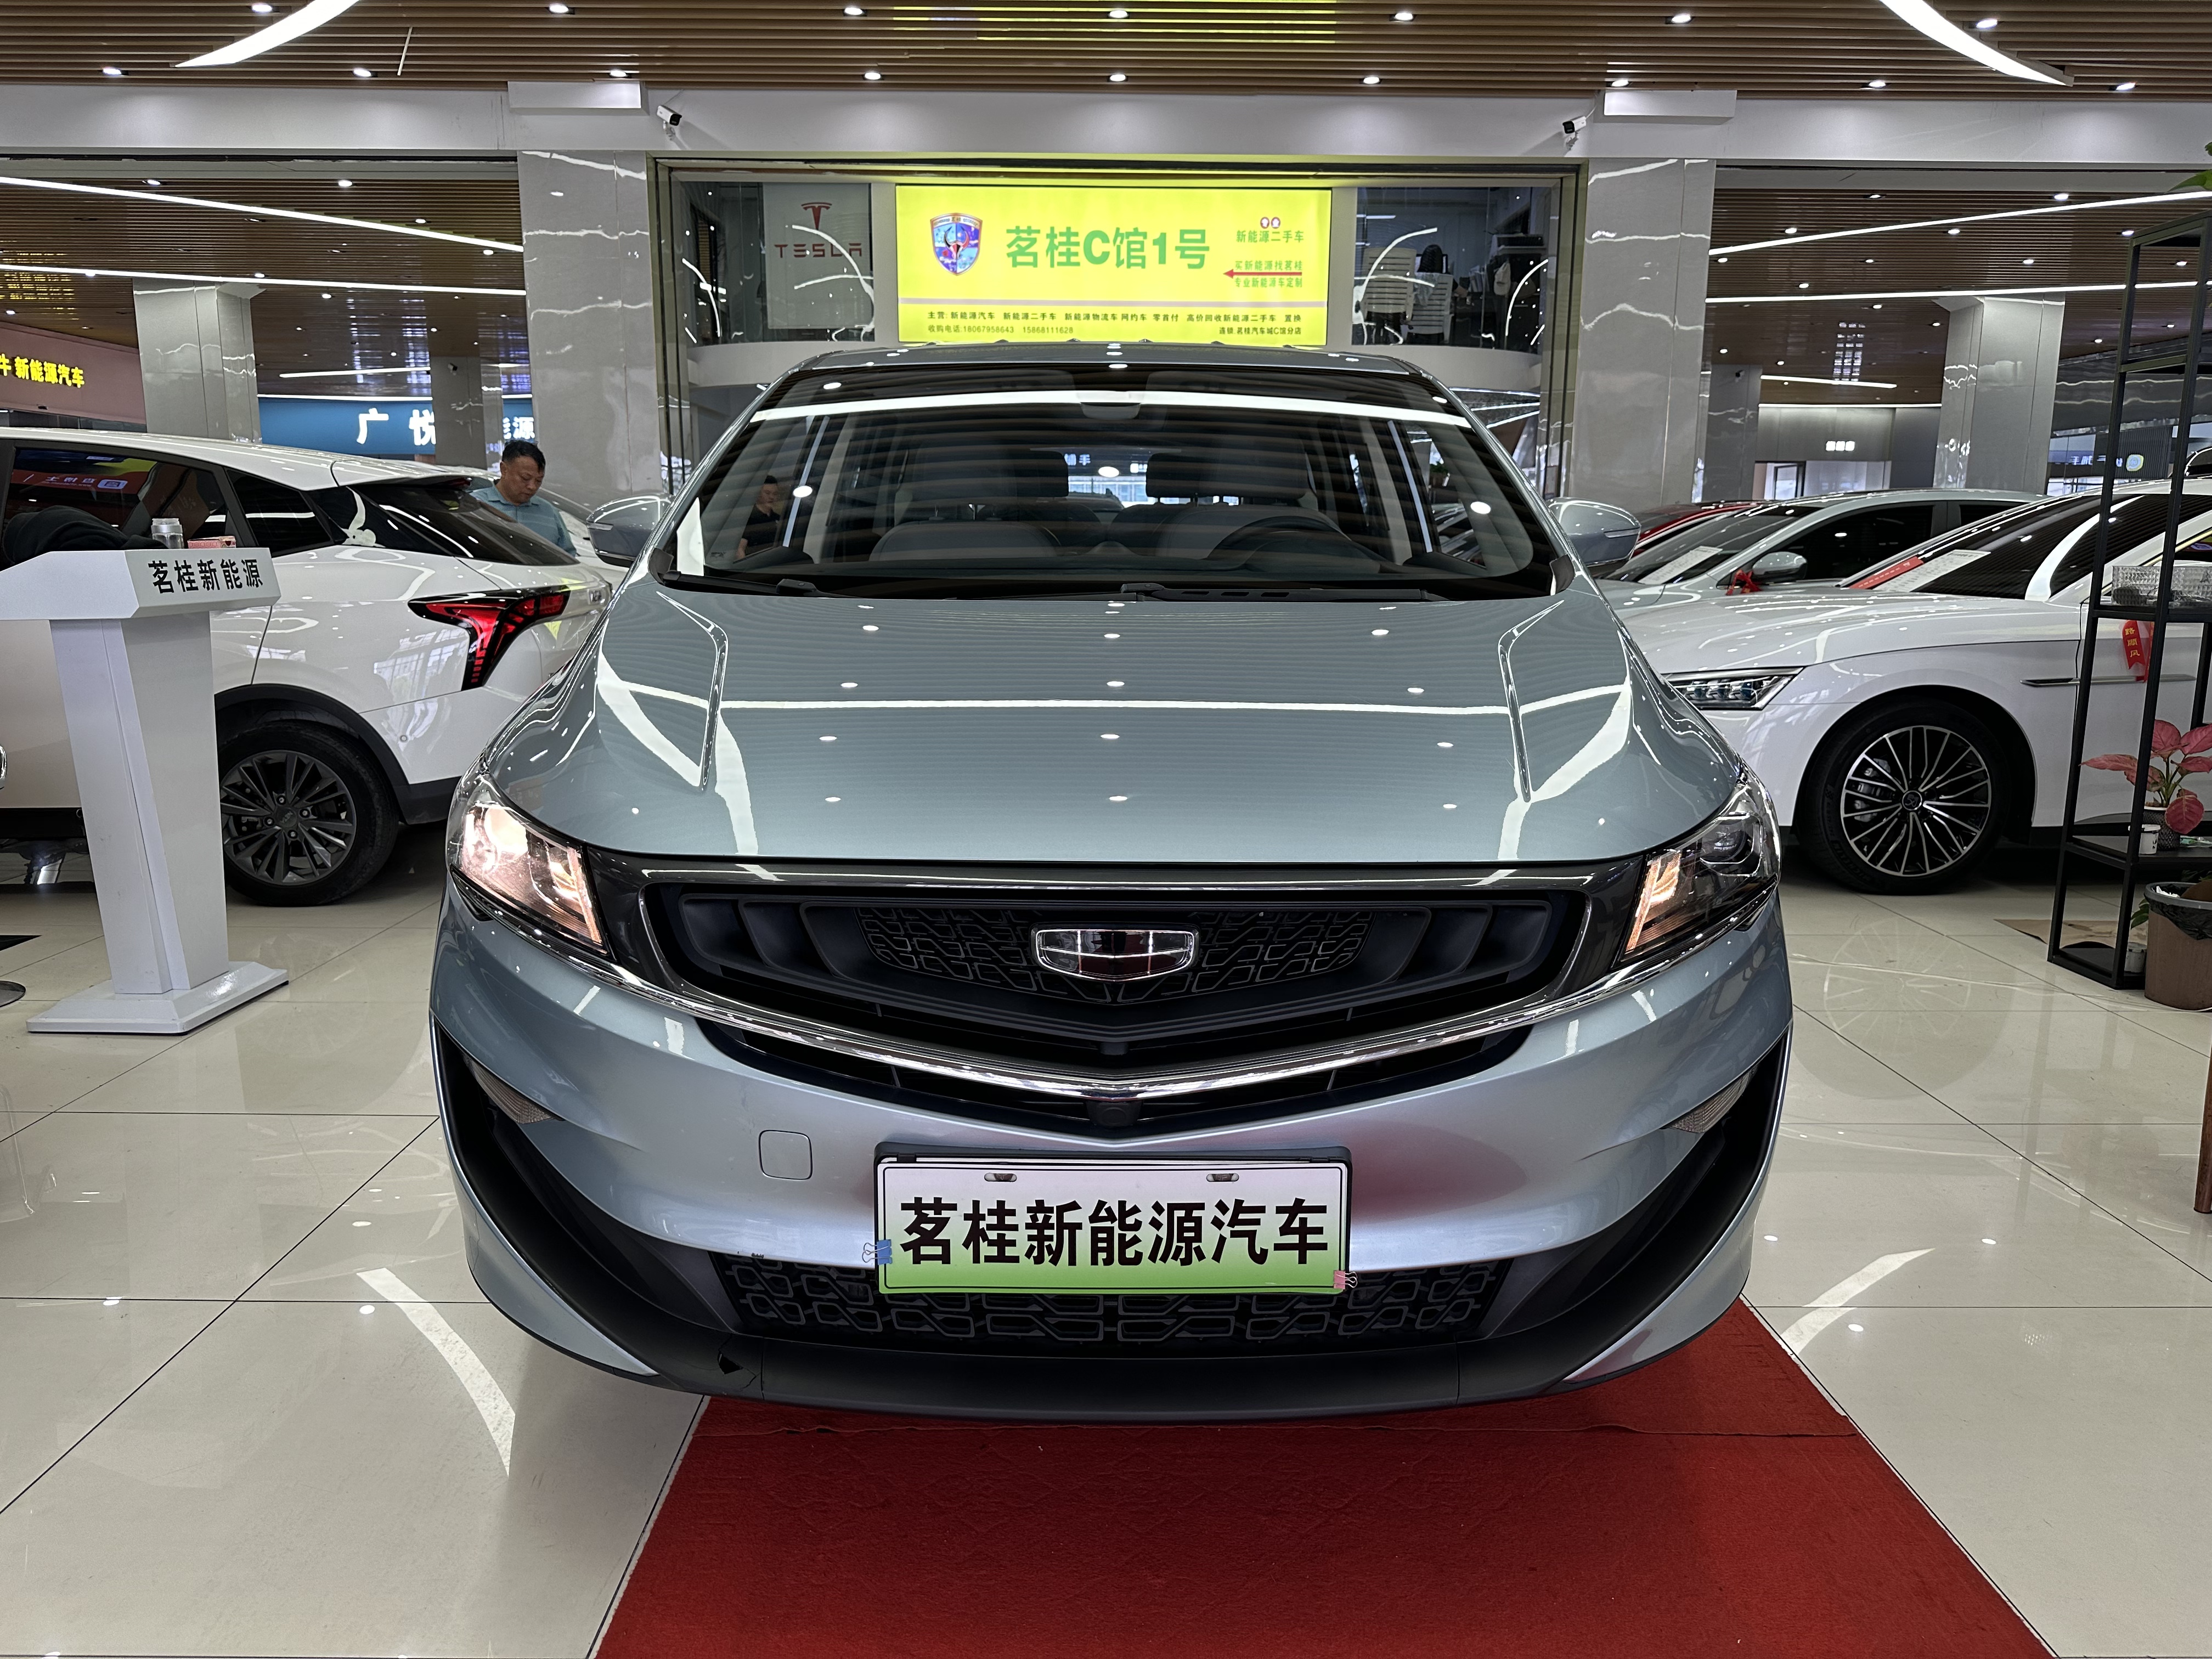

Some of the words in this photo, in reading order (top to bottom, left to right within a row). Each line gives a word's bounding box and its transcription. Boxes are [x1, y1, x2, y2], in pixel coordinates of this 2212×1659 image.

[1006, 226, 1210, 269] 茗桂C馆1号
[1236, 230, 1304, 243] 新能源二手车
[775, 243, 862, 258] TESLA
[1234, 277, 1302, 287] 专业新能源车定制
[1003, 312, 1057, 320] 新能源二手车
[14, 356, 85, 388] 新能源汽车
[148, 558, 263, 594] 茗桂新能源
[900, 1197, 1328, 1266] 茗桂新能源汽车
